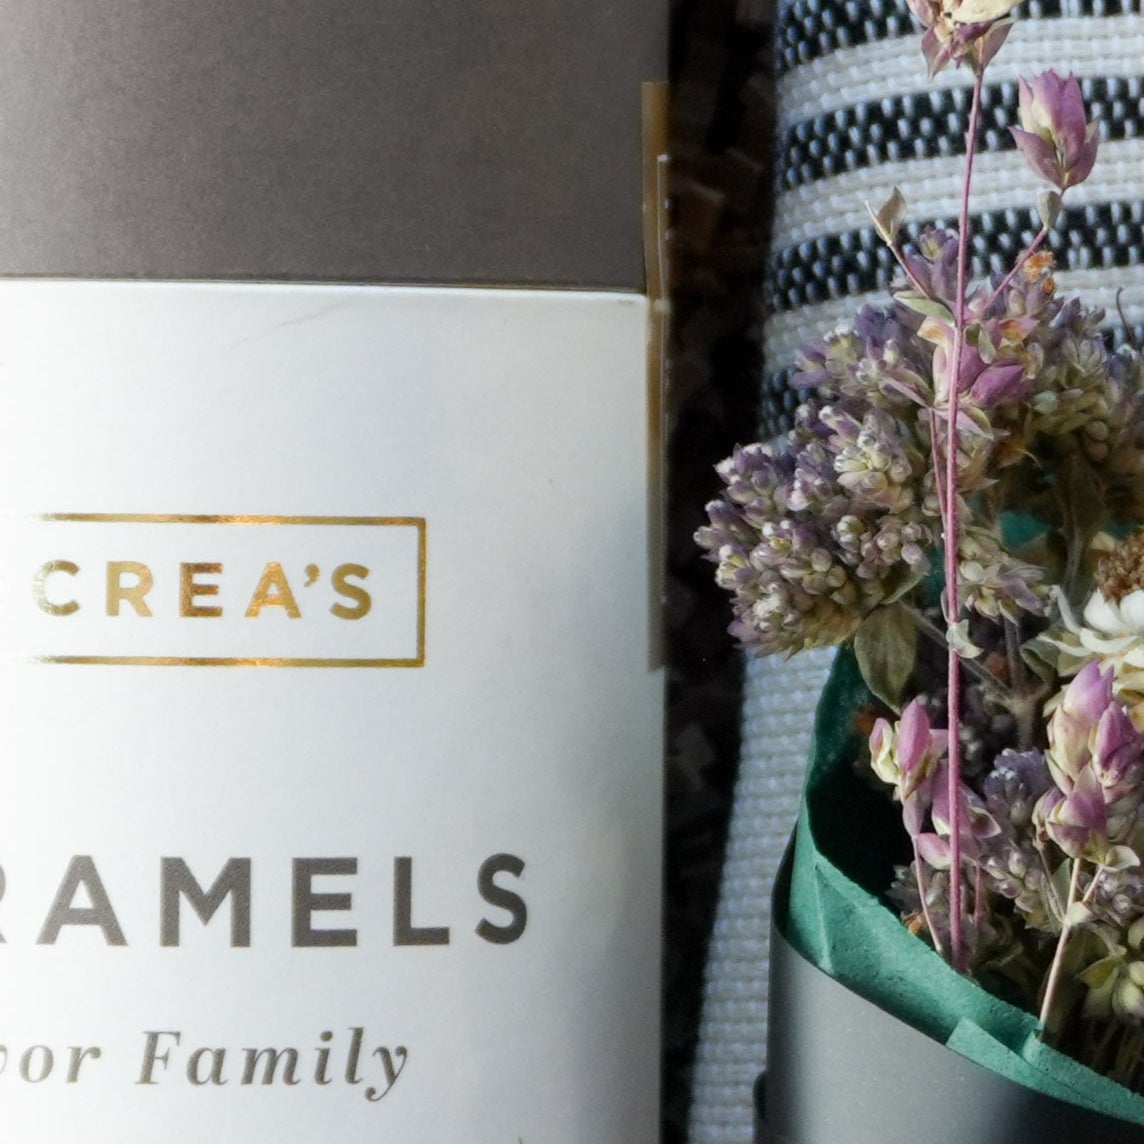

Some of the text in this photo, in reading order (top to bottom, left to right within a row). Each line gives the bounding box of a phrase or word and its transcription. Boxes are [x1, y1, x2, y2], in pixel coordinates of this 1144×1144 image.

[0, 853, 530, 950] AMELS
[0, 1026, 410, 1104] or Family
